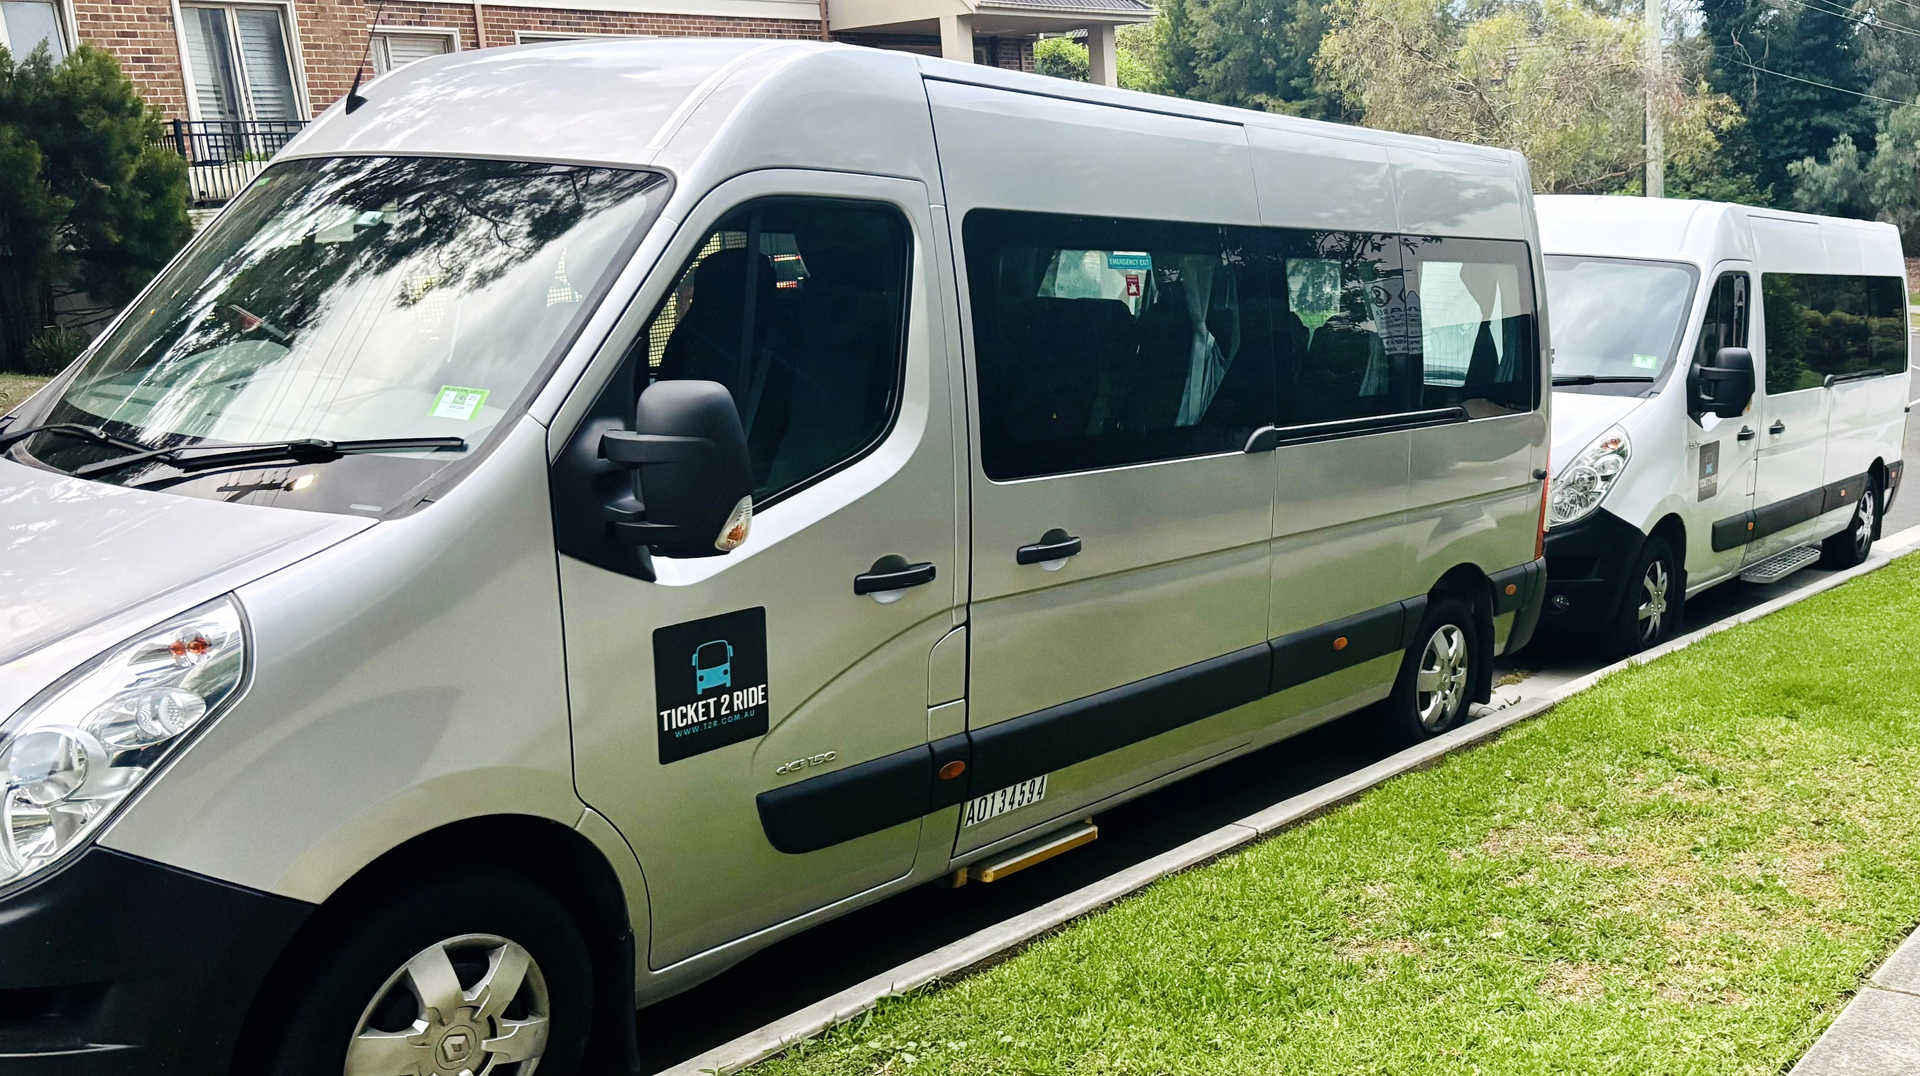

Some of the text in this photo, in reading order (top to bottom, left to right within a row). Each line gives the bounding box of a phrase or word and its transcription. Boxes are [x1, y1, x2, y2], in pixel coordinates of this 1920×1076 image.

[1109, 258, 1138, 266] EMERGENCY
[660, 684, 767, 732] TICKET 2 RIDE
[674, 709, 755, 738] WWW.T2R.COM.AU
[807, 750, 836, 767] 150
